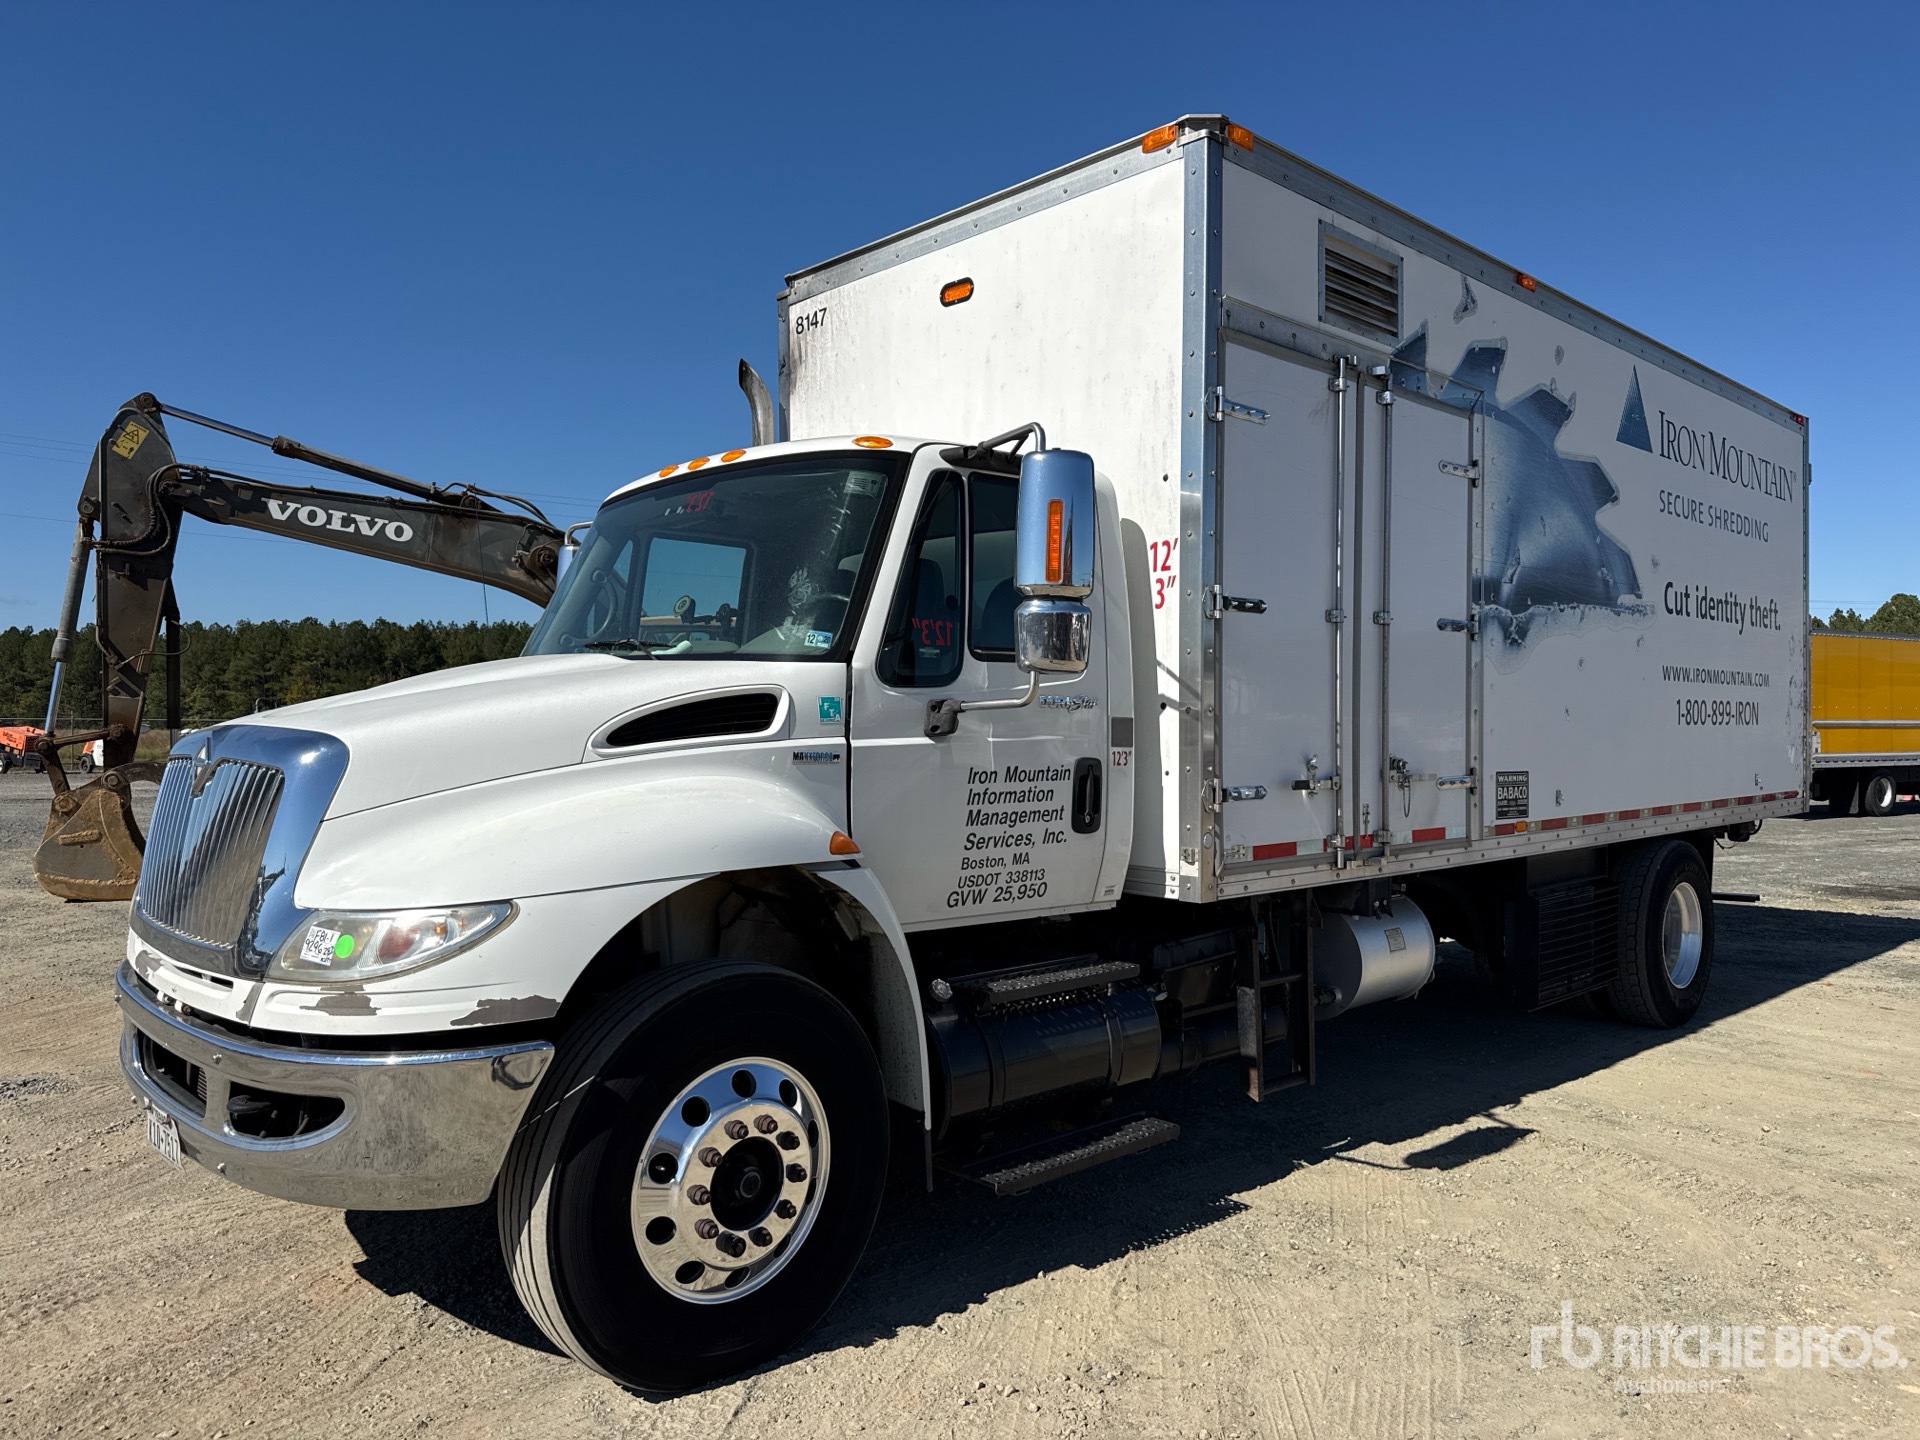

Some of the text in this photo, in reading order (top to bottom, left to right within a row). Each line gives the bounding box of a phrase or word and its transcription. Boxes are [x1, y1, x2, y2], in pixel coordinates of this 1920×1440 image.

[796, 307, 827, 335] 8147
[1658, 410, 1793, 503] IRON MOUNTAIN
[261, 497, 414, 542] VOLVO
[1659, 490, 1769, 542] SECURE SHREDDING
[1150, 537, 1179, 572] 12'
[1664, 581, 1781, 635] Cut identity theft.
[807, 633, 816, 644] 12
[1662, 665, 1770, 688] WWW.IRONMOUNTAIN.COM
[1676, 699, 1759, 726] 1-800-899-IRON
[967, 765, 1071, 785] Iron Mountain
[1498, 774, 1528, 782] WARNING
[966, 785, 1055, 806] Information
[1497, 786, 1528, 799] BABACO
[965, 805, 1065, 829] Management
[963, 828, 1068, 851] Services, Inc.
[961, 852, 1030, 870] Boston, MA
[957, 868, 1046, 889] USDOT 338113
[946, 882, 1048, 909] GVW 25,950
